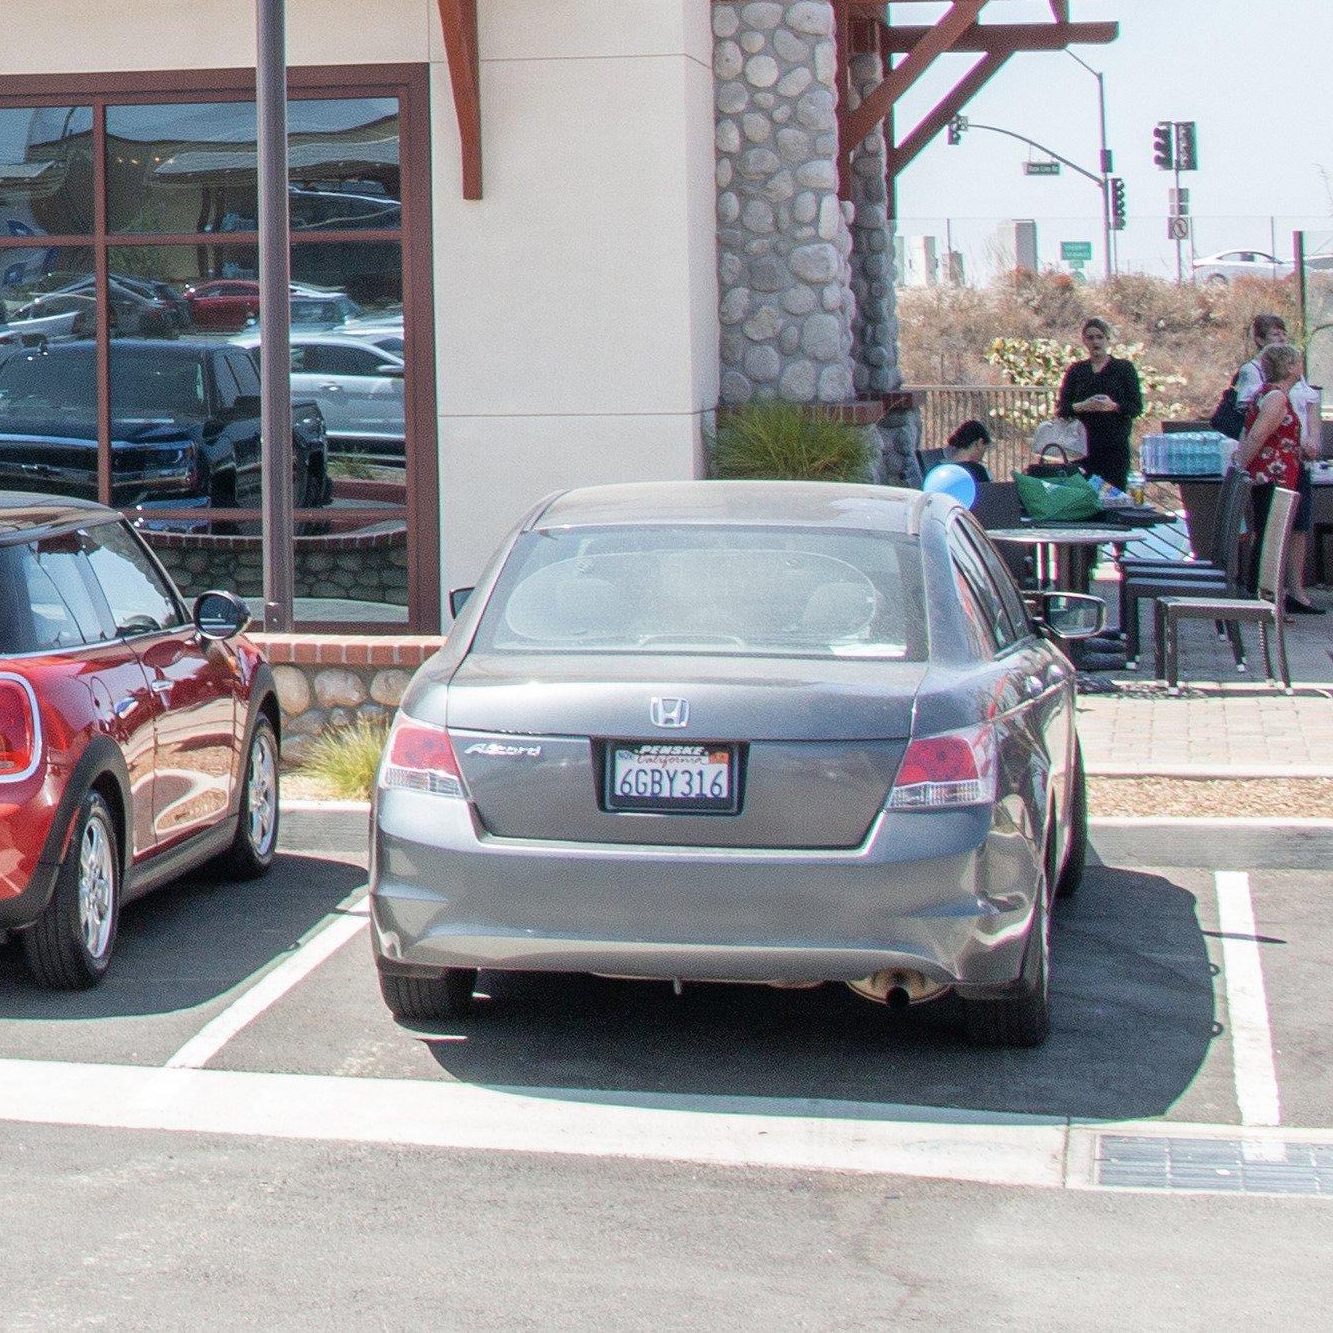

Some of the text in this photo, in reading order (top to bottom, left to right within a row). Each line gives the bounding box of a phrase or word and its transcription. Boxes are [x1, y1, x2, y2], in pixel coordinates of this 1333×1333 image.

[638, 745, 706, 755] PENSKE
[637, 754, 702, 768] California
[620, 768, 723, 797] 6GBY316
